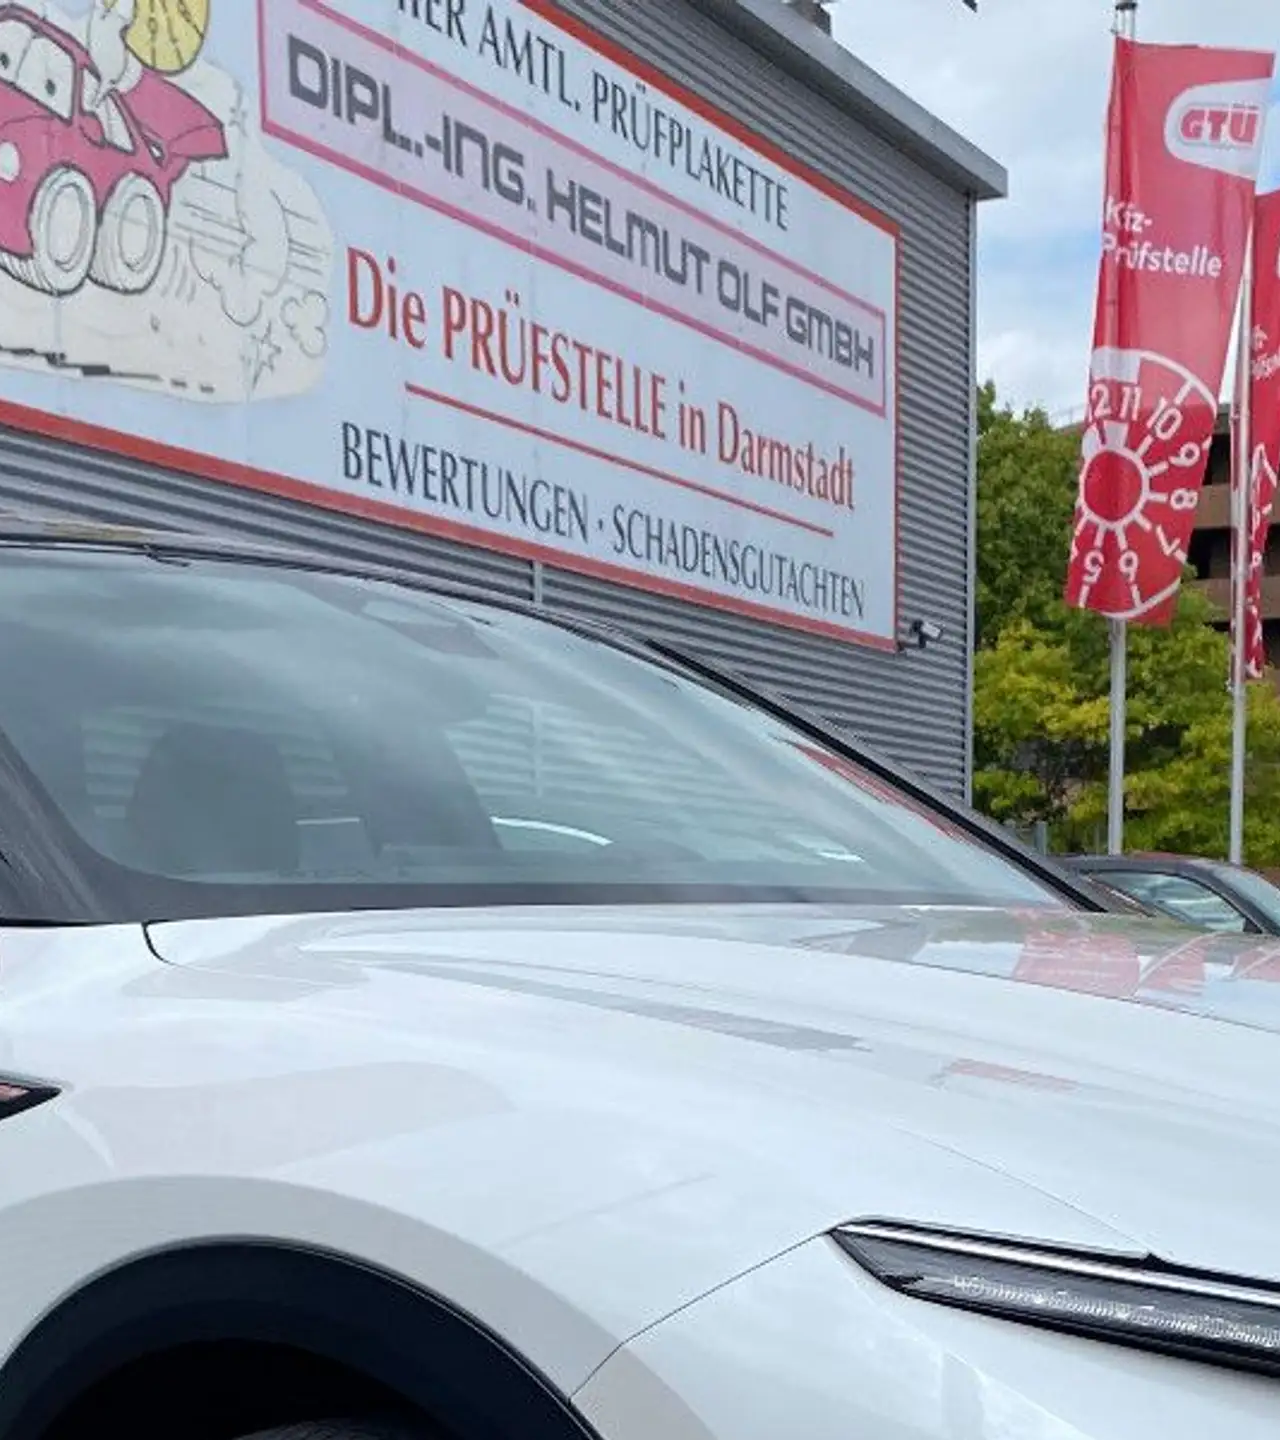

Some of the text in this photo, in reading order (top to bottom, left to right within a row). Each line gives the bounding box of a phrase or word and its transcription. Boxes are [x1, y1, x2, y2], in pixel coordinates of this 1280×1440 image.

[287, 33, 874, 379] DIPL.-ING. HELMUT OLF GMBH
[479, 5, 581, 112] AMTL.
[592, 69, 789, 232] PRÜFPLAKETTE
[1181, 103, 1259, 144] GTÜ
[347, 246, 855, 511] Die PRÜFSTELLE in Darmstadt
[1146, 397, 1182, 440] 10
[342, 421, 865, 619] BEWERTUNGEN SCHADENSGUTACHTEN
[1170, 488, 1198, 510] 8
